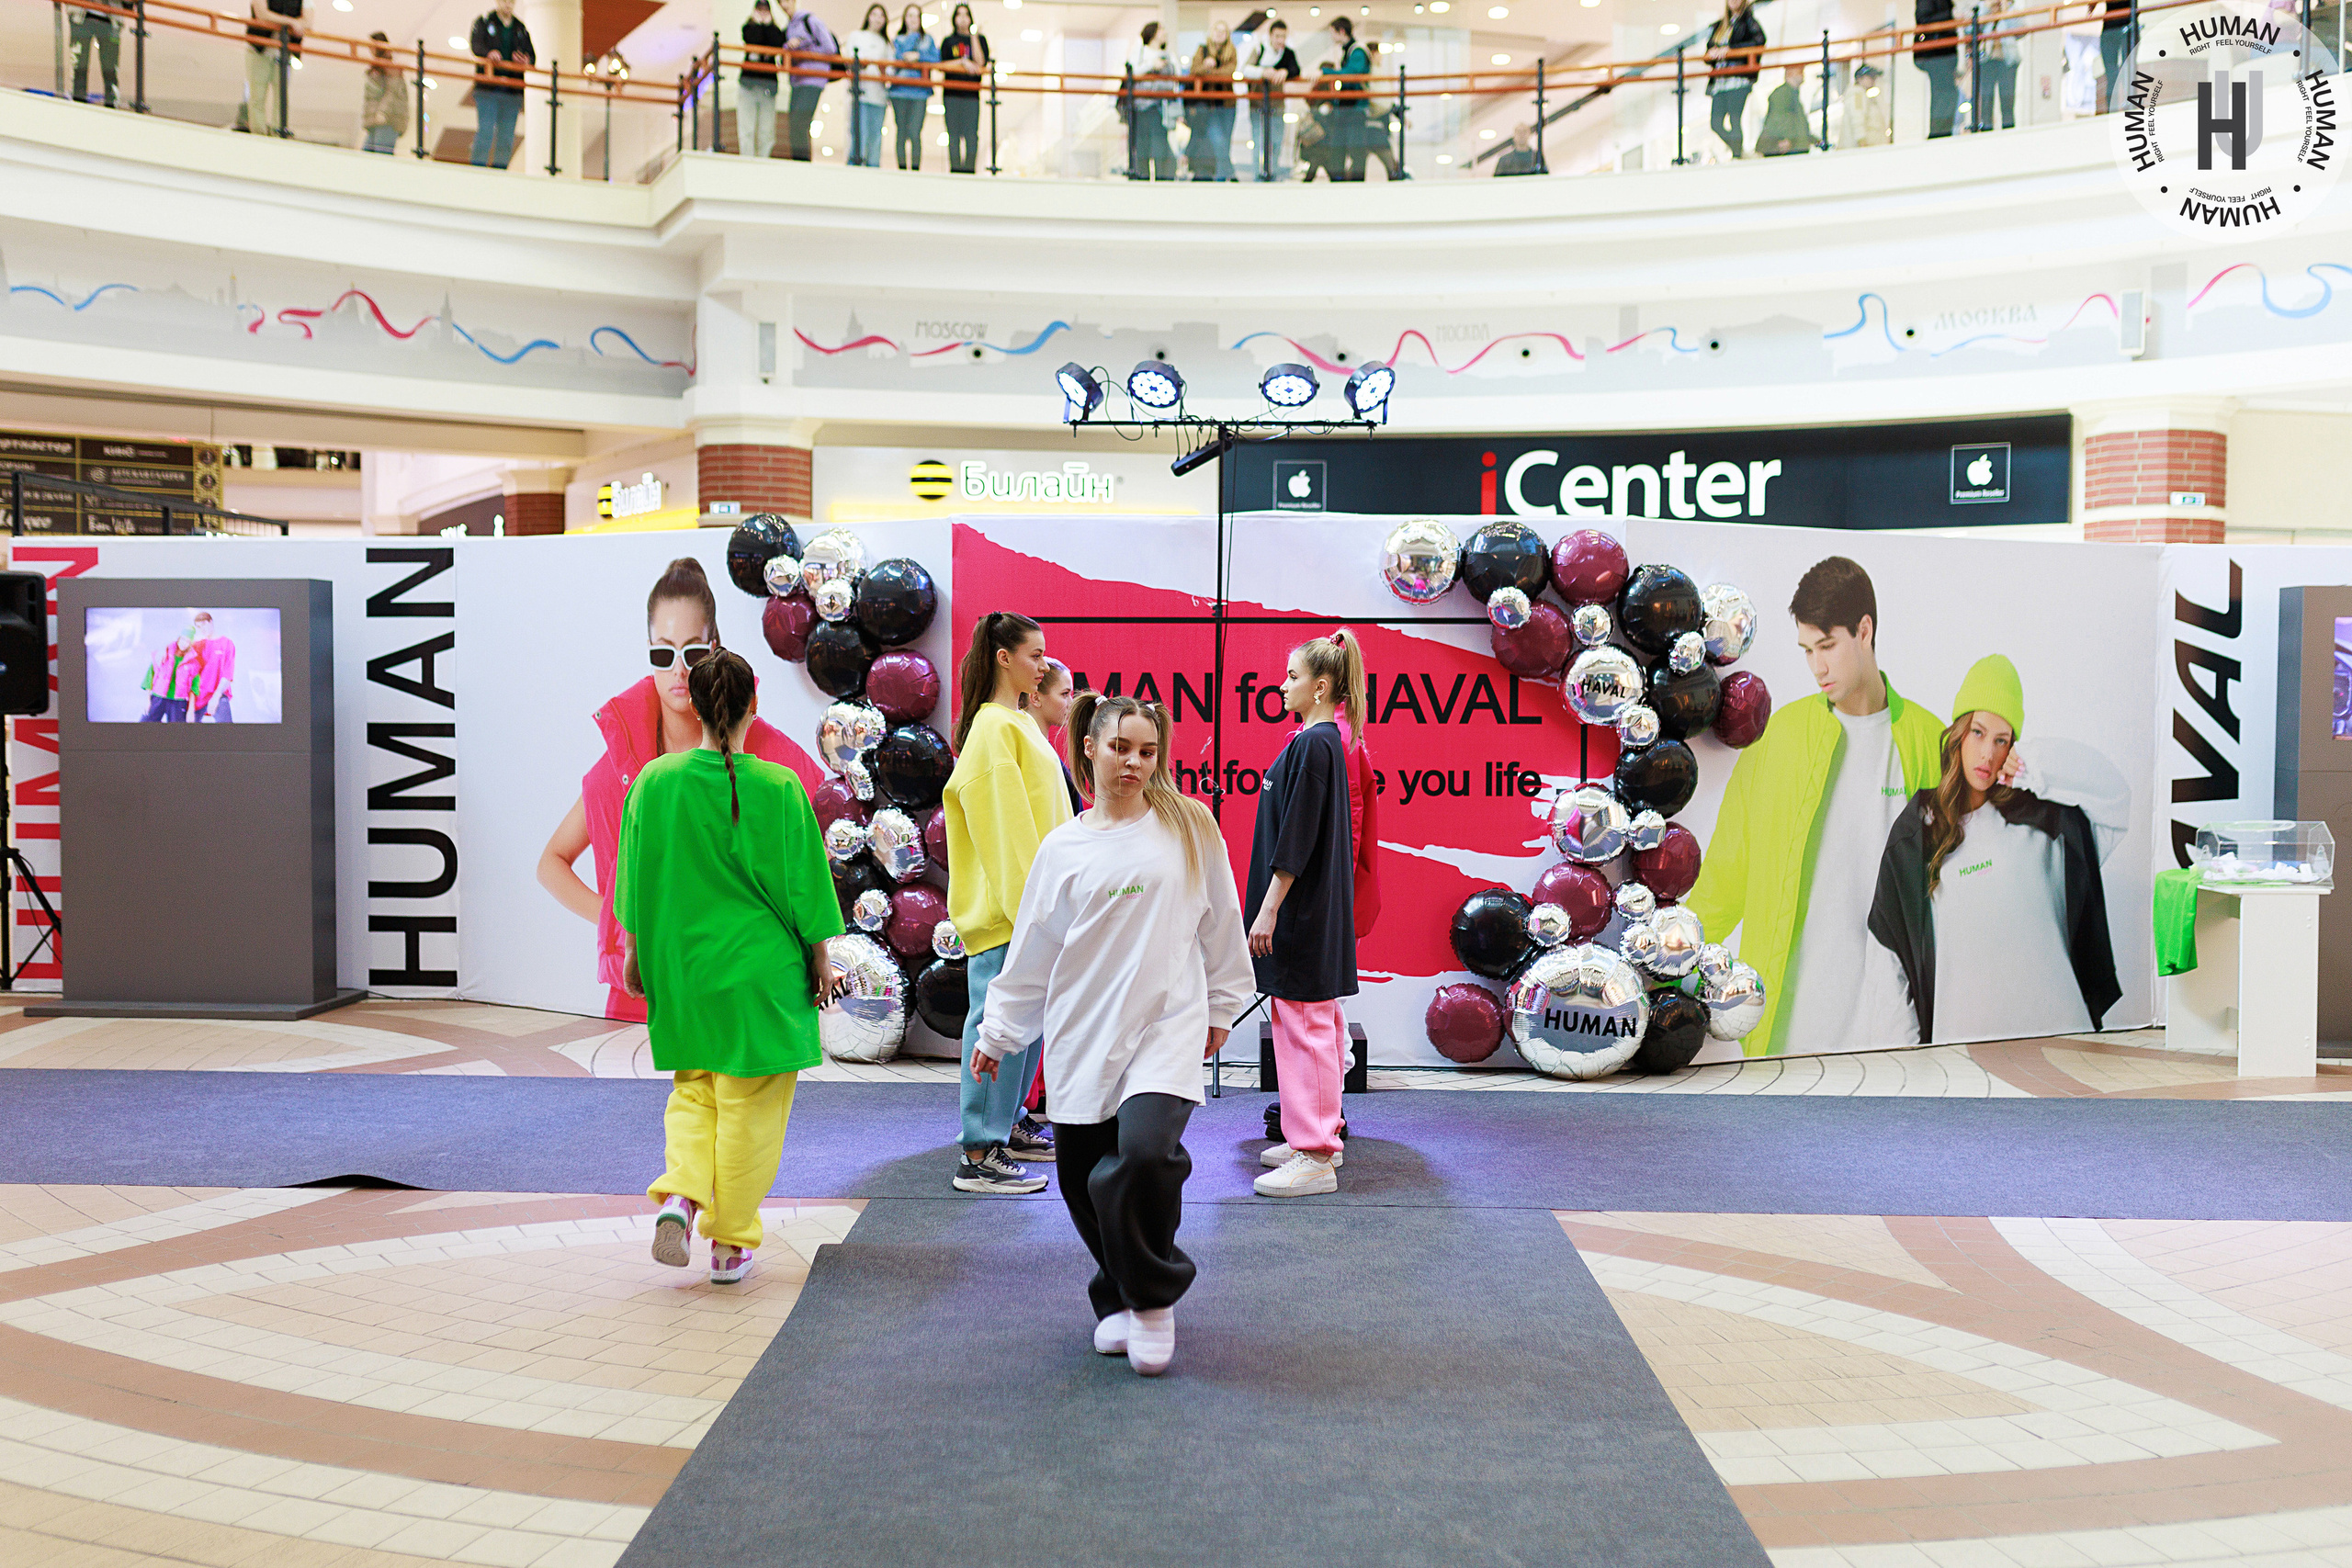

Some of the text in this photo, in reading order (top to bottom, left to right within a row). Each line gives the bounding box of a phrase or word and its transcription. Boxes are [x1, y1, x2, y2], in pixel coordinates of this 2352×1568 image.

[914, 320, 989, 340] MOSCOW
[960, 460, 1114, 504] Билайн
[1480, 448, 1782, 520] iCenter
[1236, 671, 1300, 724] fo
[1581, 678, 1626, 699] HAVAL
[366, 547, 459, 987] HUMAN
[1397, 769, 1470, 806] you
[1485, 761, 1542, 796] life
[1959, 859, 1993, 877] HUMAN
[1108, 885, 1145, 899] HUMAN
[1544, 1008, 1637, 1038] HUMAN
